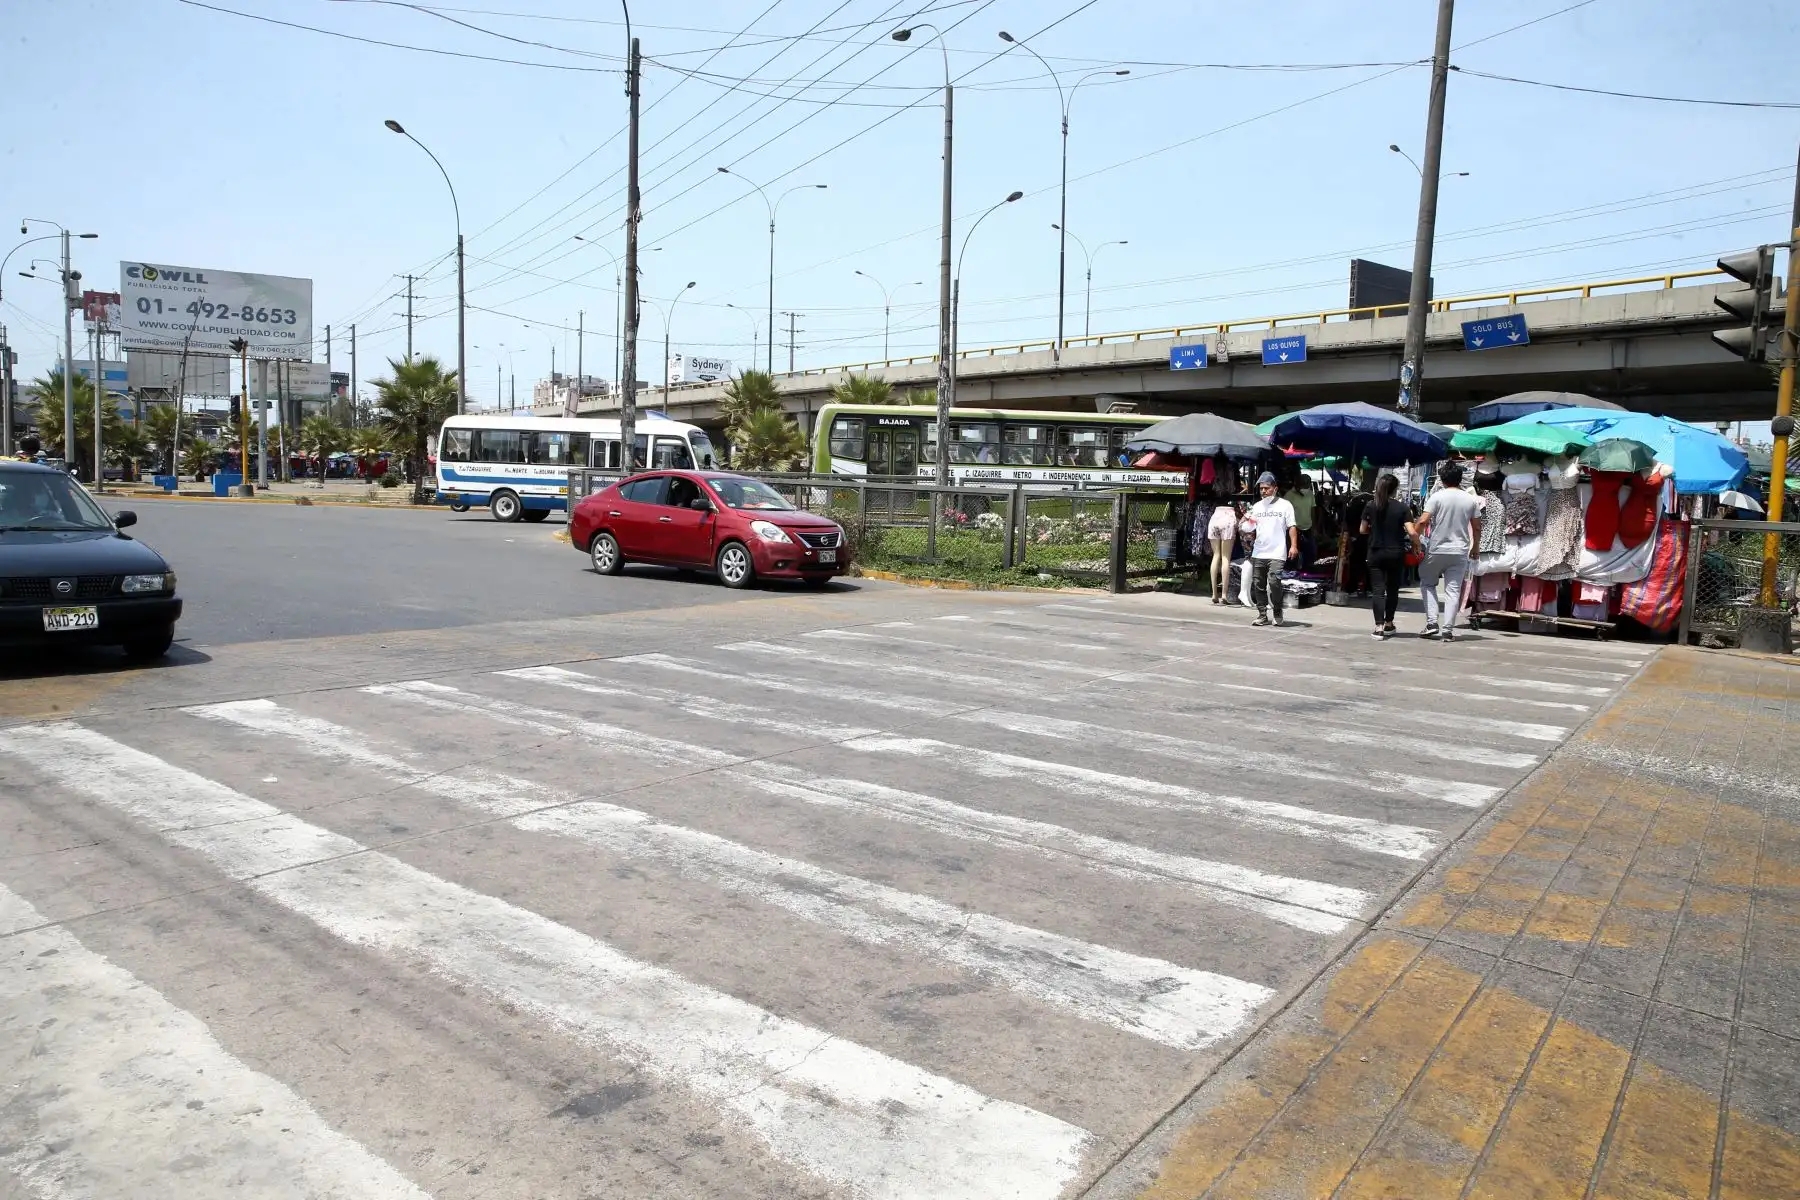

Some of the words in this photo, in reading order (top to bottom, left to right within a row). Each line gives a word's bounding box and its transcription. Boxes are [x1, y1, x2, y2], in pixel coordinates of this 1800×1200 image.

[126, 265, 208, 285] COWLL
[127, 281, 178, 291] PUBLICIDAD
[186, 301, 297, 325] 492-8653
[139, 320, 296, 338] WWW.COWLLPUBLICIDAD.COM
[1472, 324, 1492, 334] SOLO
[1497, 321, 1513, 330] BUS
[124, 337, 233, 350] ventas@cowllpublicidad.c
[1268, 343, 1278, 351] LOS
[1280, 340, 1300, 349] OLIVOS
[692, 358, 724, 371] Sydney
[879, 418, 911, 426] BAJADA
[972, 469, 1002, 478] IZAGUIRRE
[1013, 471, 1032, 479] METRO
[1102, 474, 1112, 482] UNI
[1257, 510, 1283, 518] adidas
[47, 612, 96, 628] AWD-219
